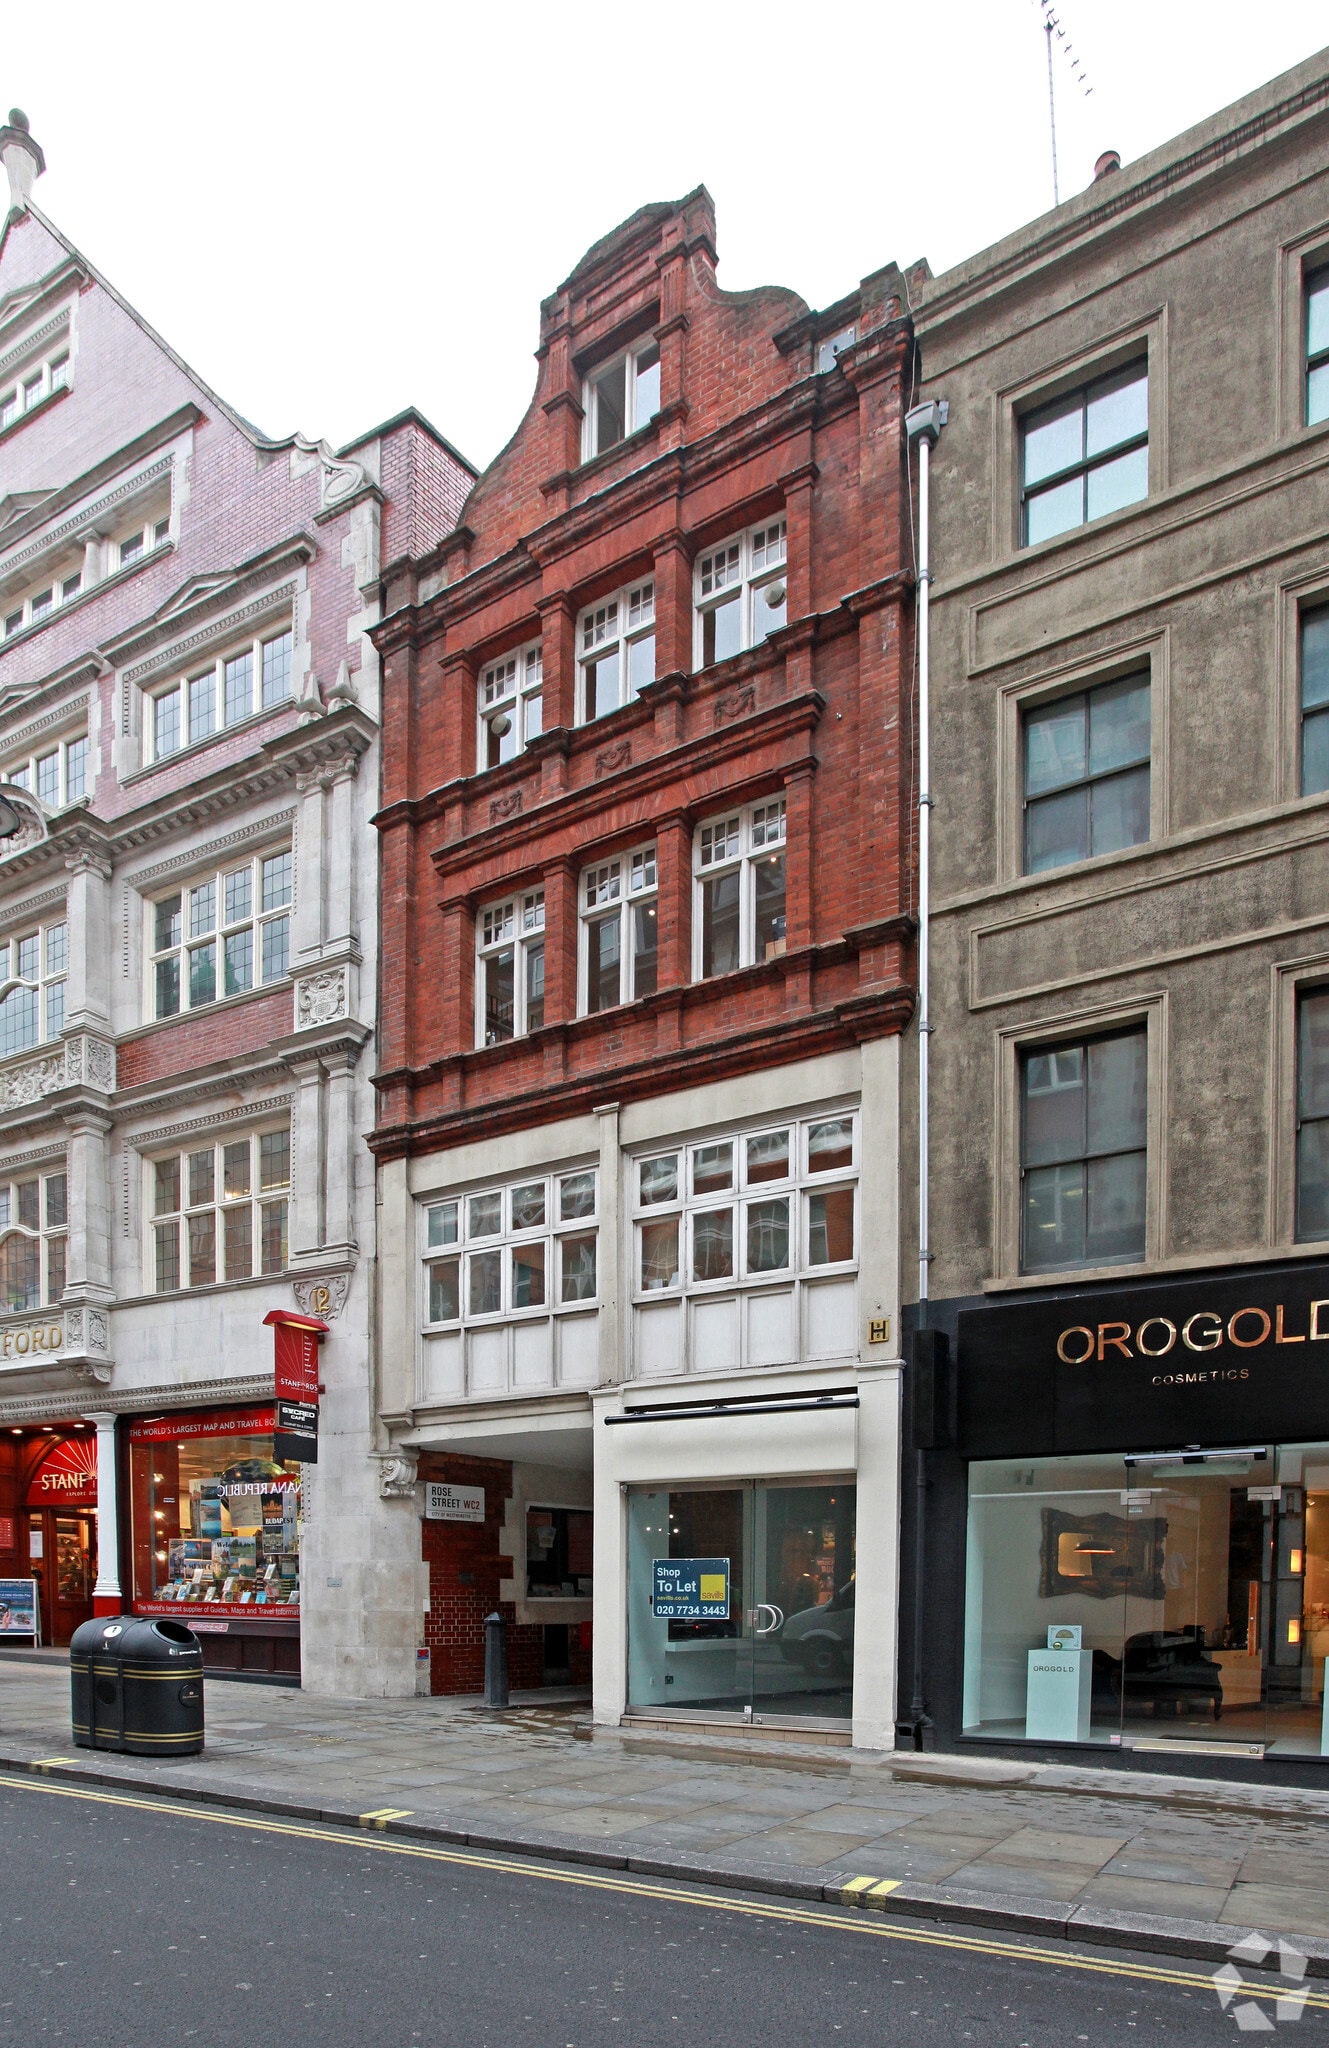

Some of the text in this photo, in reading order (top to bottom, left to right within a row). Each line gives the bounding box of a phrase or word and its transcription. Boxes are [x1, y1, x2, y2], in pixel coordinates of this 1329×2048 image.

[313, 1287, 330, 1313] 12
[3, 1326, 62, 1356] FORD
[1152, 1368, 1250, 1386] COSMETICS
[130, 1429, 142, 1437] THE
[143, 1427, 172, 1436] WORLD'S
[172, 1424, 201, 1434] LARGEST
[203, 1422, 218, 1431] MAP
[219, 1421, 235, 1430] AND
[236, 1419, 263, 1429] TRAVEL
[431, 1486, 452, 1496] ROSE
[431, 1497, 480, 1510] STREET WC2
[657, 1567, 681, 1578] Shop
[657, 1580, 697, 1592] To Let
[702, 1591, 724, 1599] savills
[147, 1604, 165, 1612] World's
[165, 1605, 182, 1614] largest
[183, 1605, 203, 1614] supplier
[210, 1606, 229, 1615] Guides,
[231, 1607, 245, 1615] Maps
[258, 1607, 274, 1615] Travel
[657, 1606, 726, 1615] 020 7734 3443
